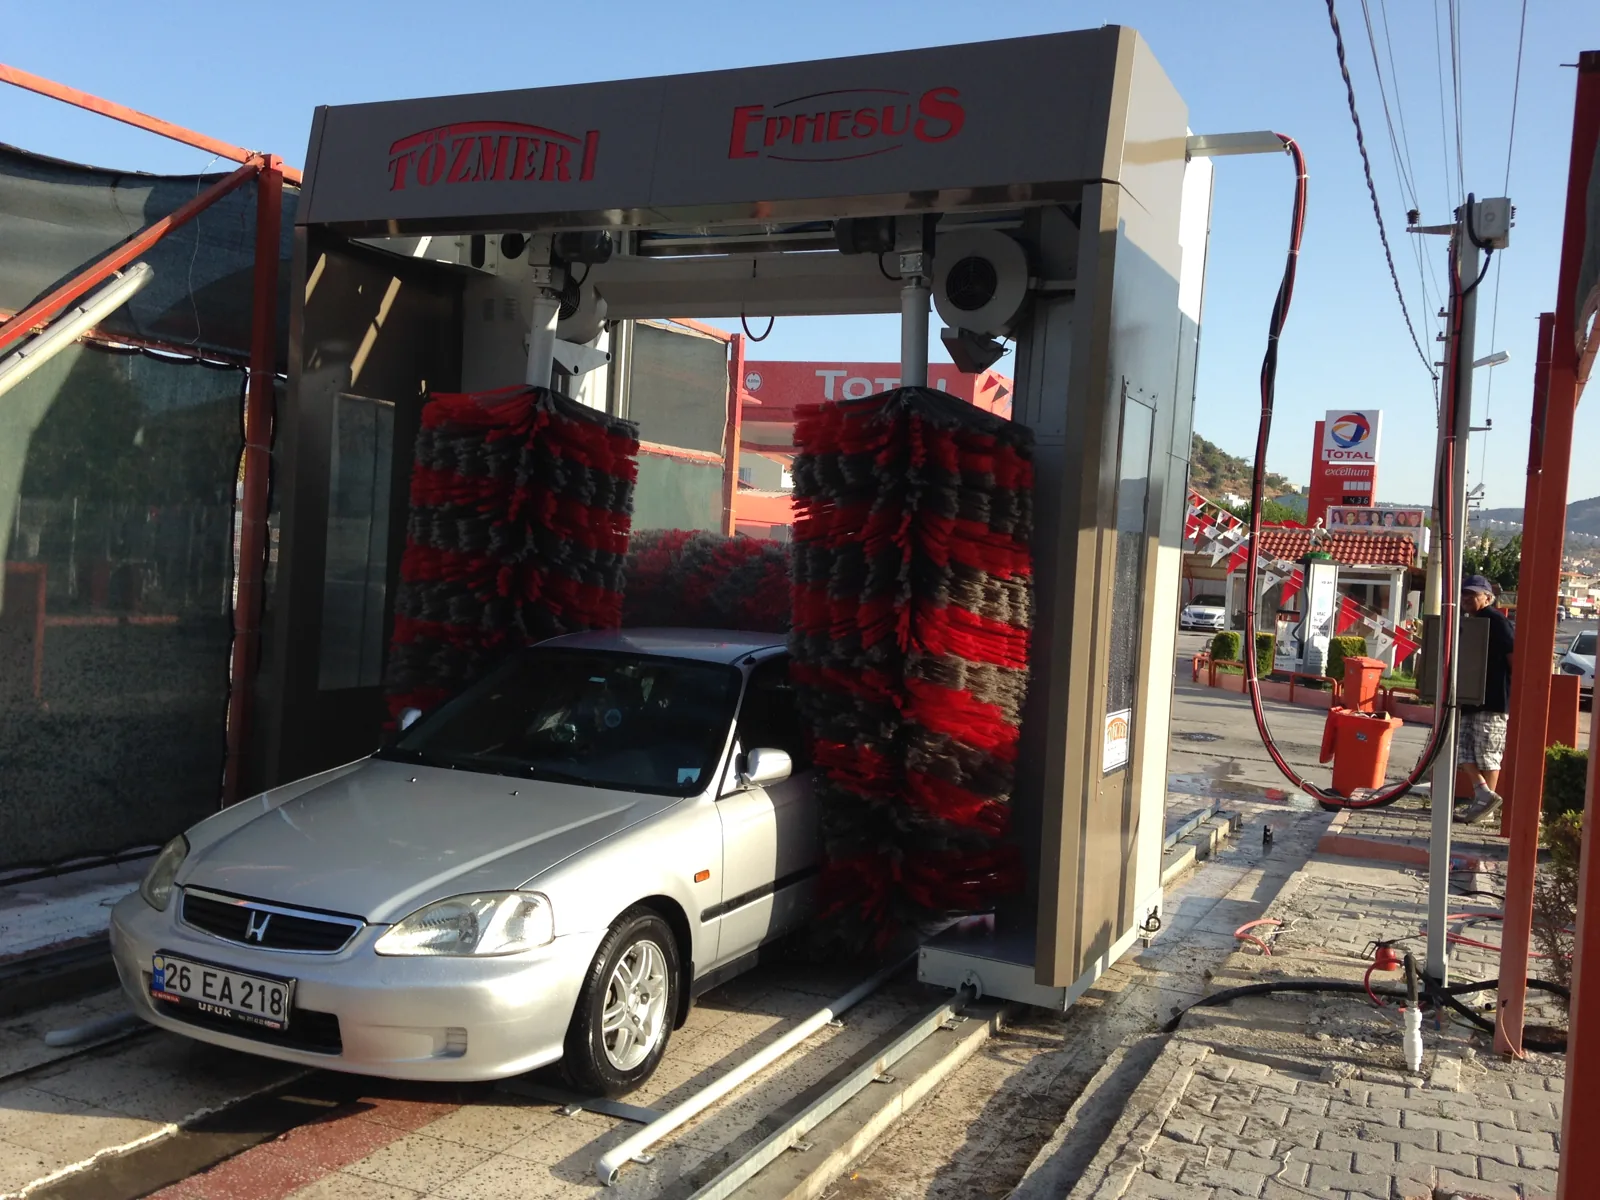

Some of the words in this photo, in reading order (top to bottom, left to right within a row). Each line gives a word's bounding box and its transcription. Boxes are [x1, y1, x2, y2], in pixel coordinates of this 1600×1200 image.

[1324, 448, 1373, 459] TOTAL
[1324, 466, 1370, 477] excellium
[165, 963, 191, 993] 26
[202, 971, 234, 1005] EA
[240, 981, 283, 1016] 218
[198, 1002, 232, 1017] UFUK
